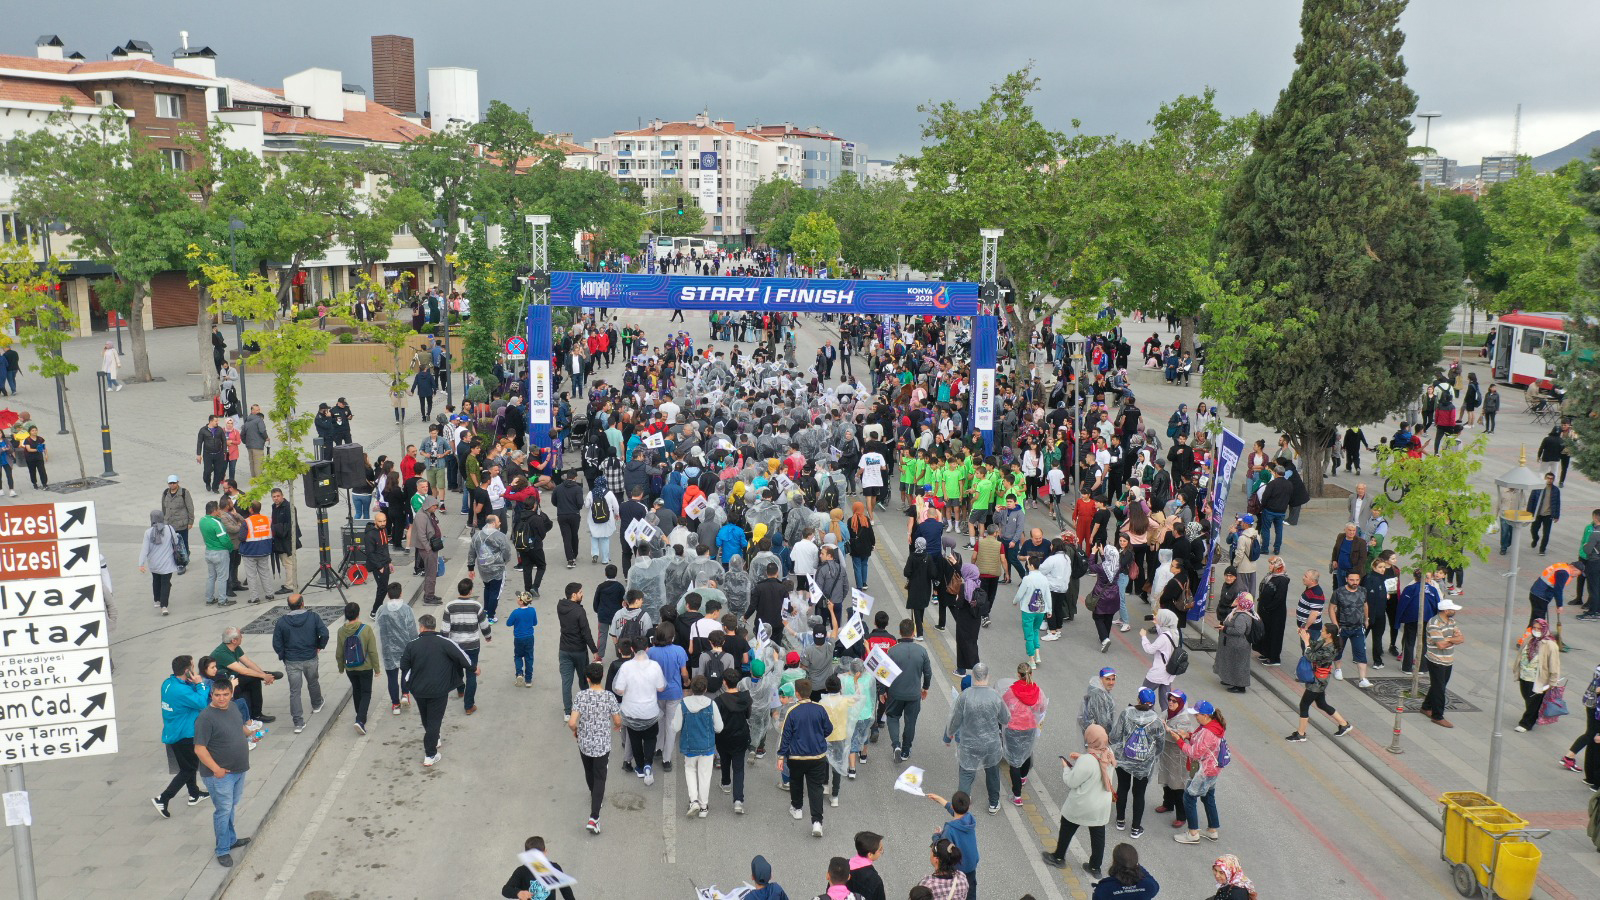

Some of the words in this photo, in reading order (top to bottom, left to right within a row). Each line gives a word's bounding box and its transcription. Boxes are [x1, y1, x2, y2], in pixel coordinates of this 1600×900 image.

[680, 286, 759, 302] START
[775, 288, 855, 305] FINISH
[907, 287, 933, 295] KONYA
[0, 545, 58, 572] üzesi
[0, 585, 64, 617] lya
[3, 622, 69, 647] rta
[9, 653, 65, 665] Belediyesi
[32, 692, 76, 717] Cad.
[5, 732, 24, 742] ve
[29, 726, 78, 740] Tarım
[0, 738, 80, 760] sitesi
